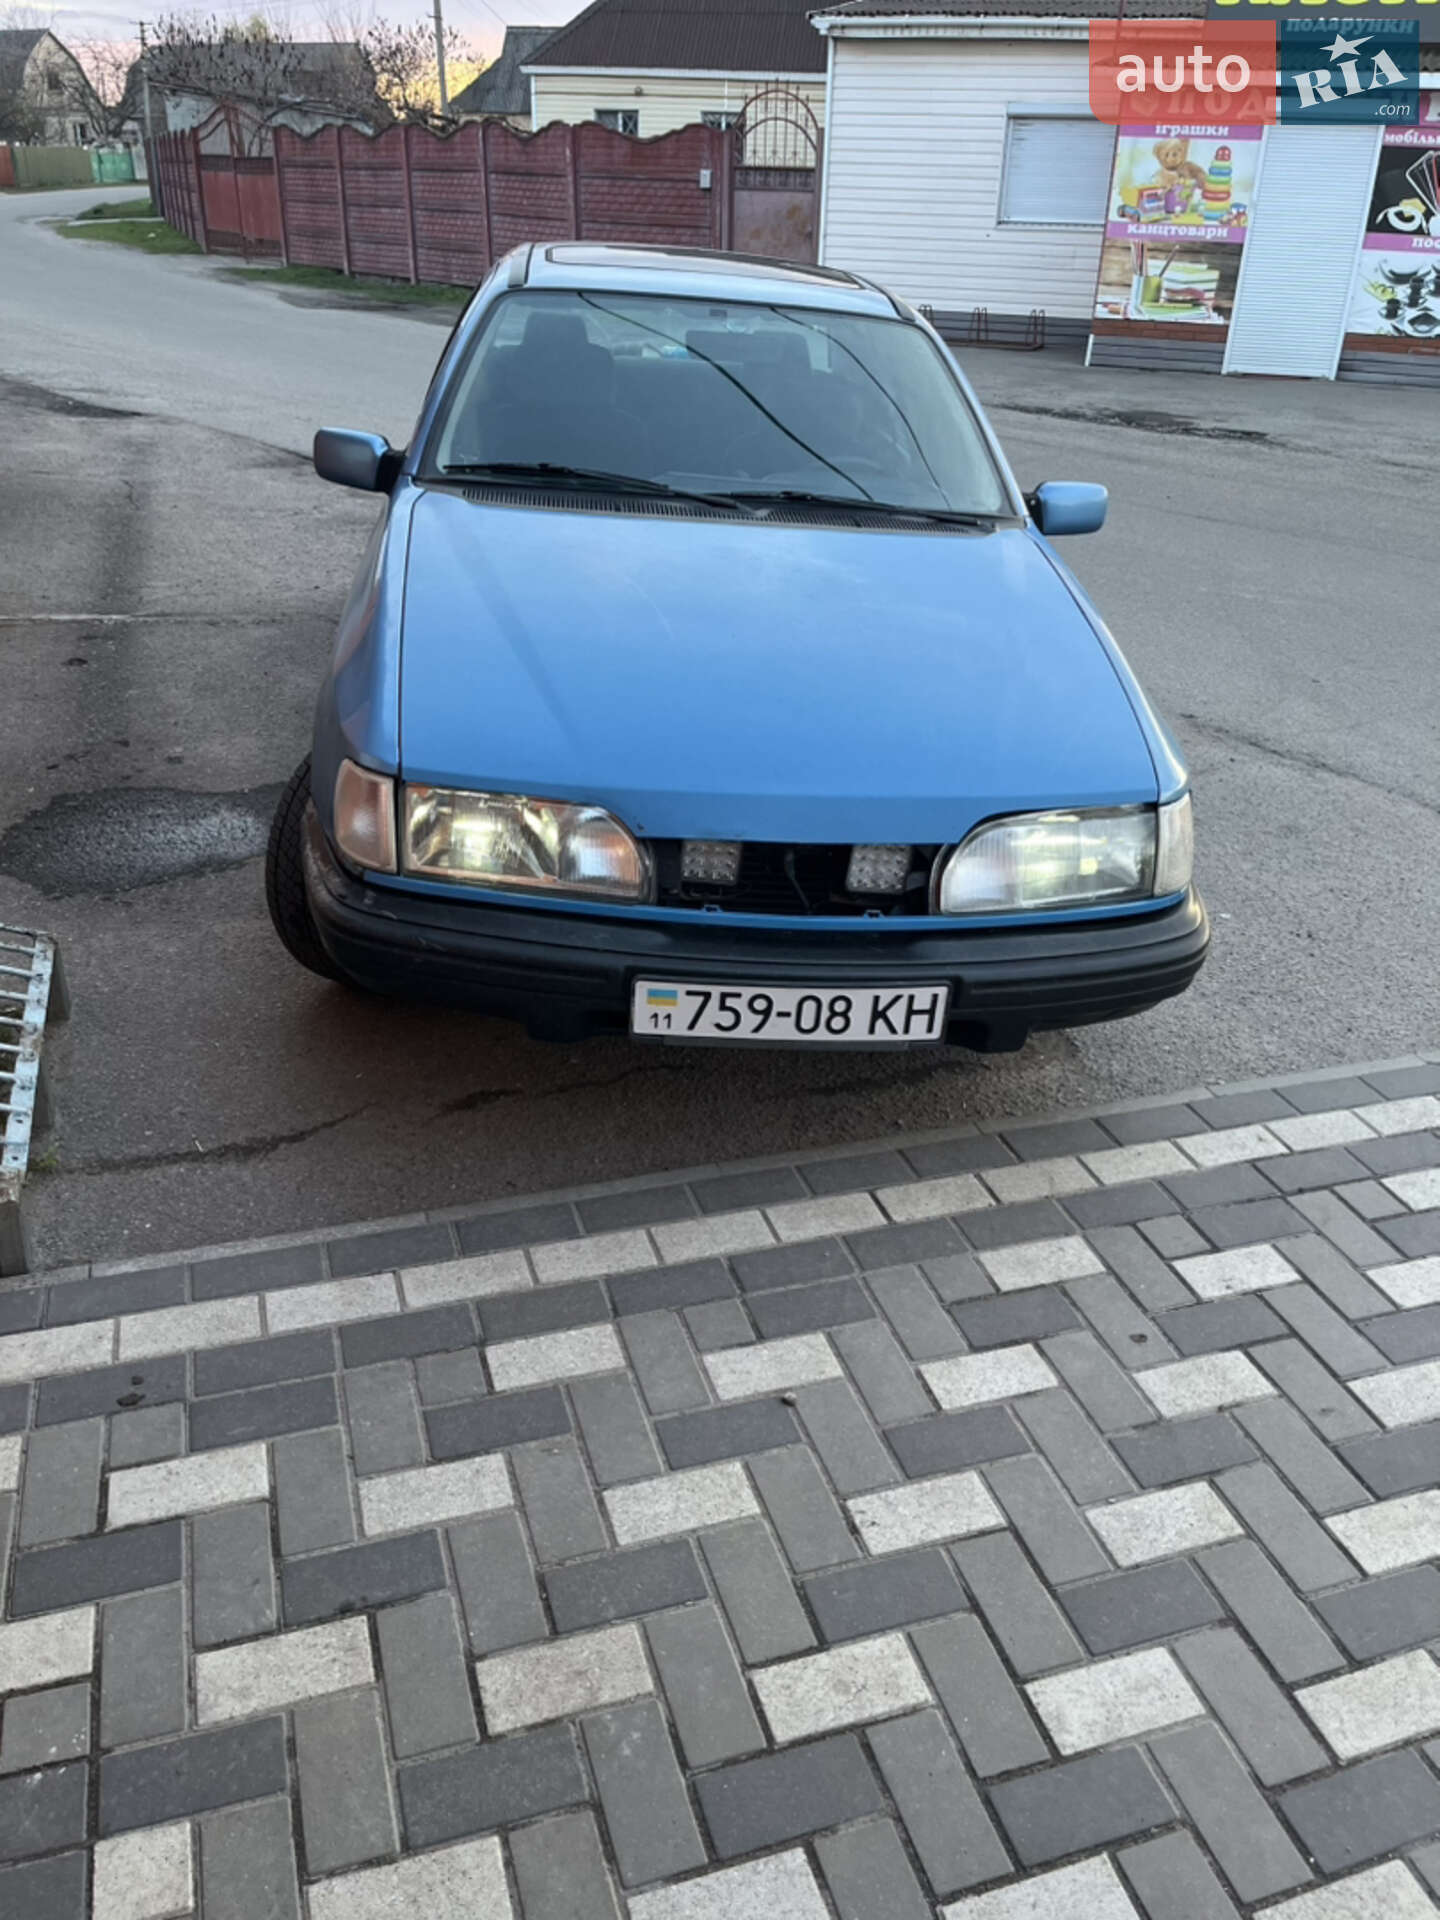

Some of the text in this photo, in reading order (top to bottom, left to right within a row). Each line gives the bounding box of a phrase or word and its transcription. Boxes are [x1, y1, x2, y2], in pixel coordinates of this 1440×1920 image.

[1155, 124, 1230, 138] іграшки
[1384, 129, 1440, 145] мобіль
[1126, 222, 1229, 240] канцтовари
[649, 1012, 673, 1030] 11
[684, 989, 853, 1036] 759-08
